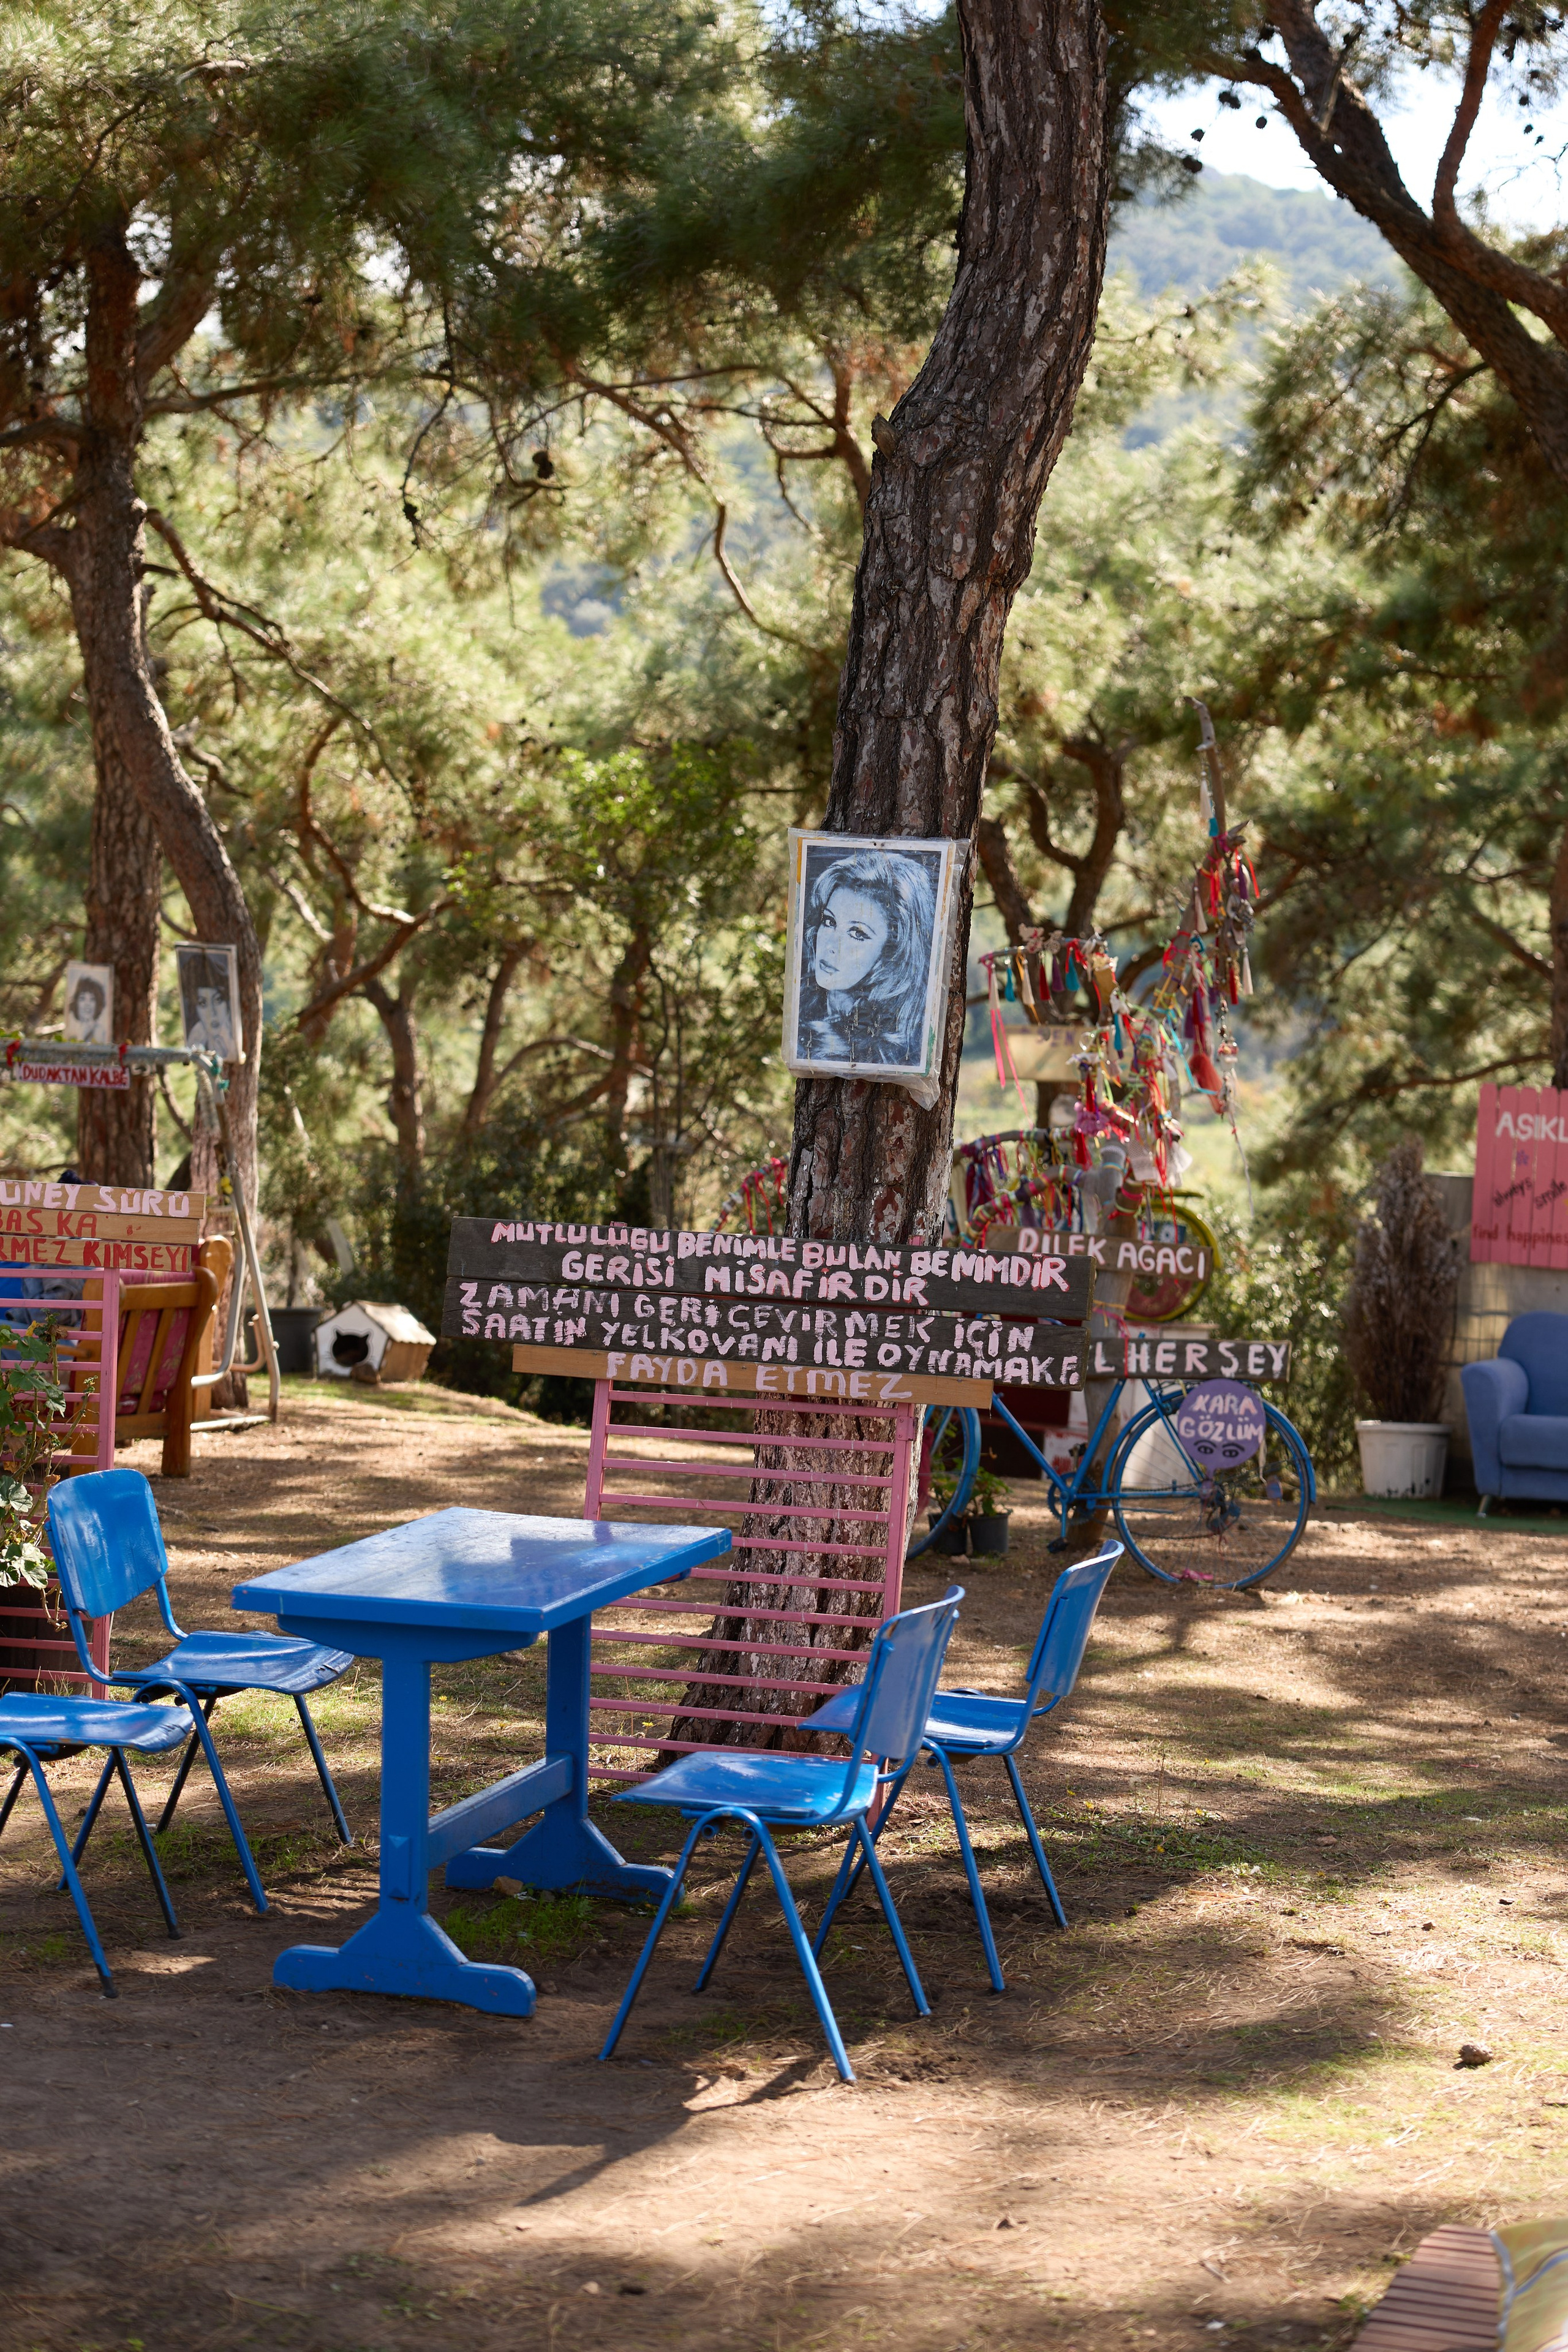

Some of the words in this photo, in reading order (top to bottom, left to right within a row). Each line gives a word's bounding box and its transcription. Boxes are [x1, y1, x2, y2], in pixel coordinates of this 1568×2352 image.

[562, 1250, 675, 1287] GERİSİ
[802, 1242, 902, 1272] BULAN
[459, 1281, 619, 1318] ZAMANI
[601, 1321, 797, 1363] YELKOVANI
[606, 1351, 728, 1387] FAYDA
[756, 1364, 912, 1400] ETMEZ
[1192, 1393, 1257, 1415] KARA
[1179, 1415, 1264, 1442] GÖZLÜM
